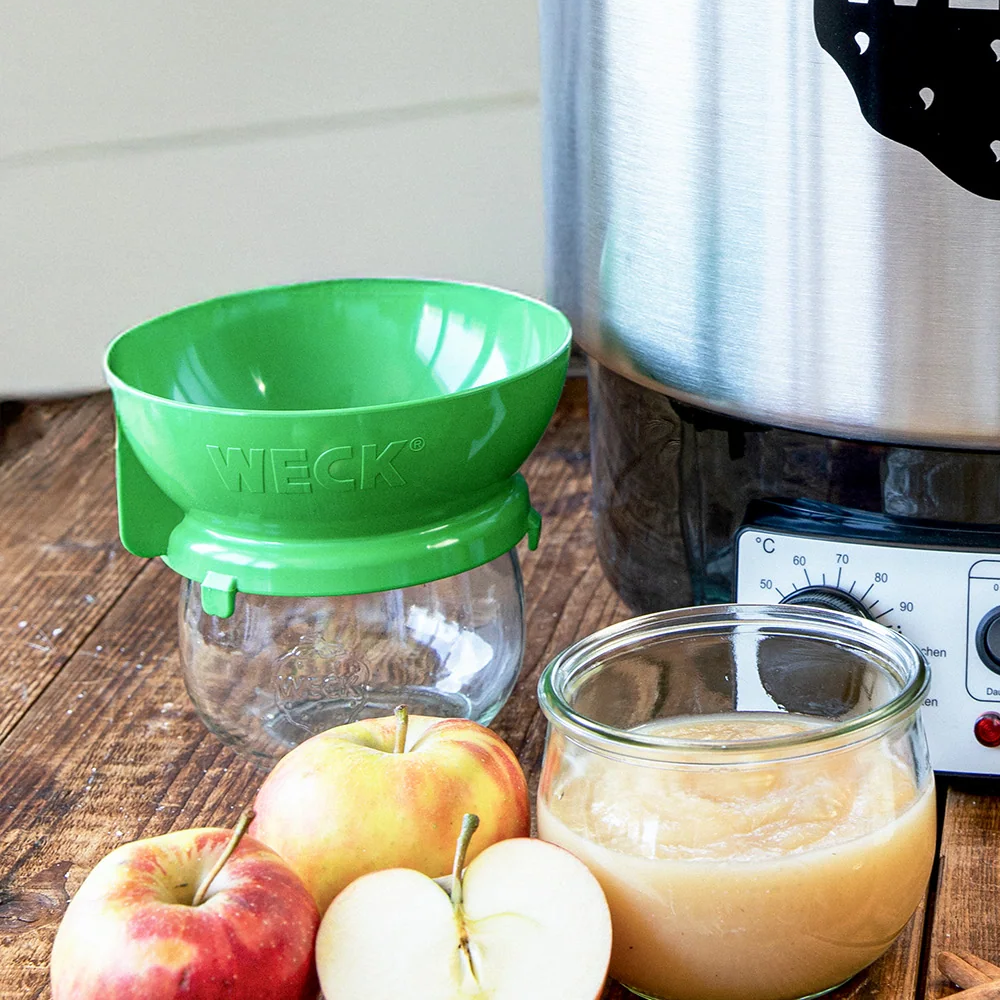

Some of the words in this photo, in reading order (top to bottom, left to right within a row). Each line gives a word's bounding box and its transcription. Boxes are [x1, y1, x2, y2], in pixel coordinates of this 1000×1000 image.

[755, 536, 776, 553] °C
[792, 555, 807, 567] 60
[835, 553, 849, 565] 70
[874, 572, 889, 584] 80
[759, 579, 773, 590] 50
[899, 601, 915, 613] 90
